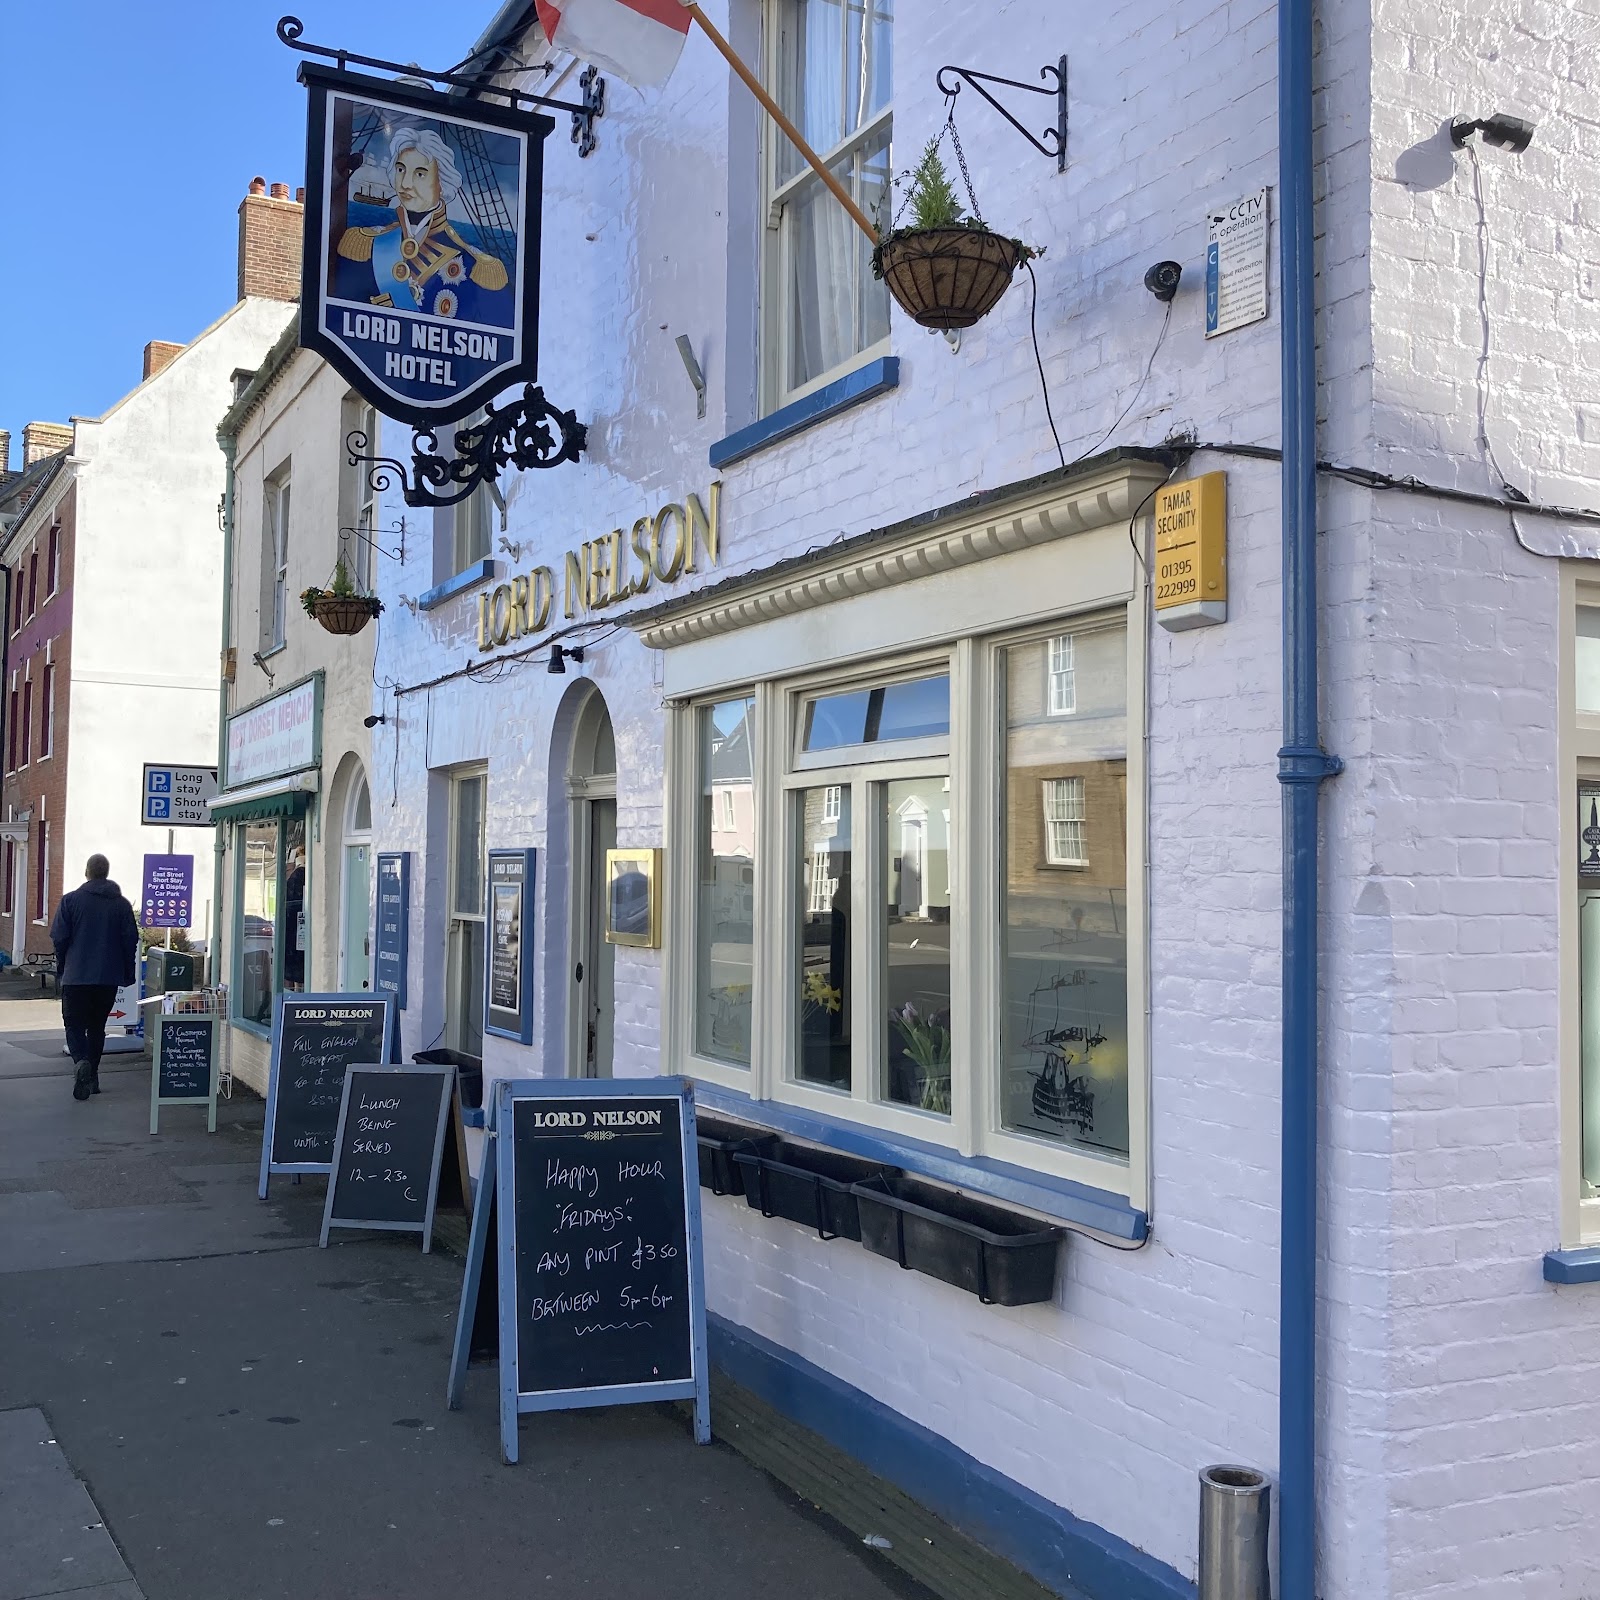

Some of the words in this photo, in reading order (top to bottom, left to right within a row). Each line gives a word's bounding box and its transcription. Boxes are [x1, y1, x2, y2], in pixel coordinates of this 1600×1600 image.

[1229, 194, 1263, 221] CCTV
[1209, 231, 1217, 242] in
[1220, 212, 1262, 237] operation
[1234, 258, 1262, 274] PREVENTION
[342, 311, 401, 345] LORD
[411, 323, 498, 362] NELSON
[385, 351, 457, 387] HOTEL
[1163, 490, 1190, 513] TAMAR
[1157, 509, 1196, 535] SECURITY
[479, 565, 552, 652] LORD
[564, 480, 722, 619] NELSON
[1161, 559, 1192, 579] 01395
[1157, 578, 1196, 599] 222999
[229, 722, 246, 750] WEST
[249, 708, 276, 743] DORSET
[279, 691, 313, 732] MENCAP
[152, 774, 166, 790] P
[175, 772, 203, 783] Long
[176, 785, 201, 795] stay
[151, 799, 165, 816] P
[174, 797, 207, 807] Short
[178, 810, 202, 820] stay
[494, 864, 506, 874] LORD
[507, 864, 523, 874] NELSON
[171, 966, 185, 976] 27
[295, 1009, 326, 1019] LORD
[329, 1009, 373, 1018] NELSON
[321, 1036, 359, 1049] ENGLISH
[359, 1093, 401, 1110] LUNCH
[357, 1117, 397, 1131] BEING
[534, 1112, 587, 1127] LORD
[593, 1110, 661, 1126] NELSON
[352, 1139, 392, 1154] SERVED
[350, 1169, 365, 1182] 12
[618, 1160, 666, 1182] HOUR
[536, 1252, 570, 1276] ANY
[585, 1241, 623, 1270] PINT
[531, 1290, 600, 1320] BETWEEN
